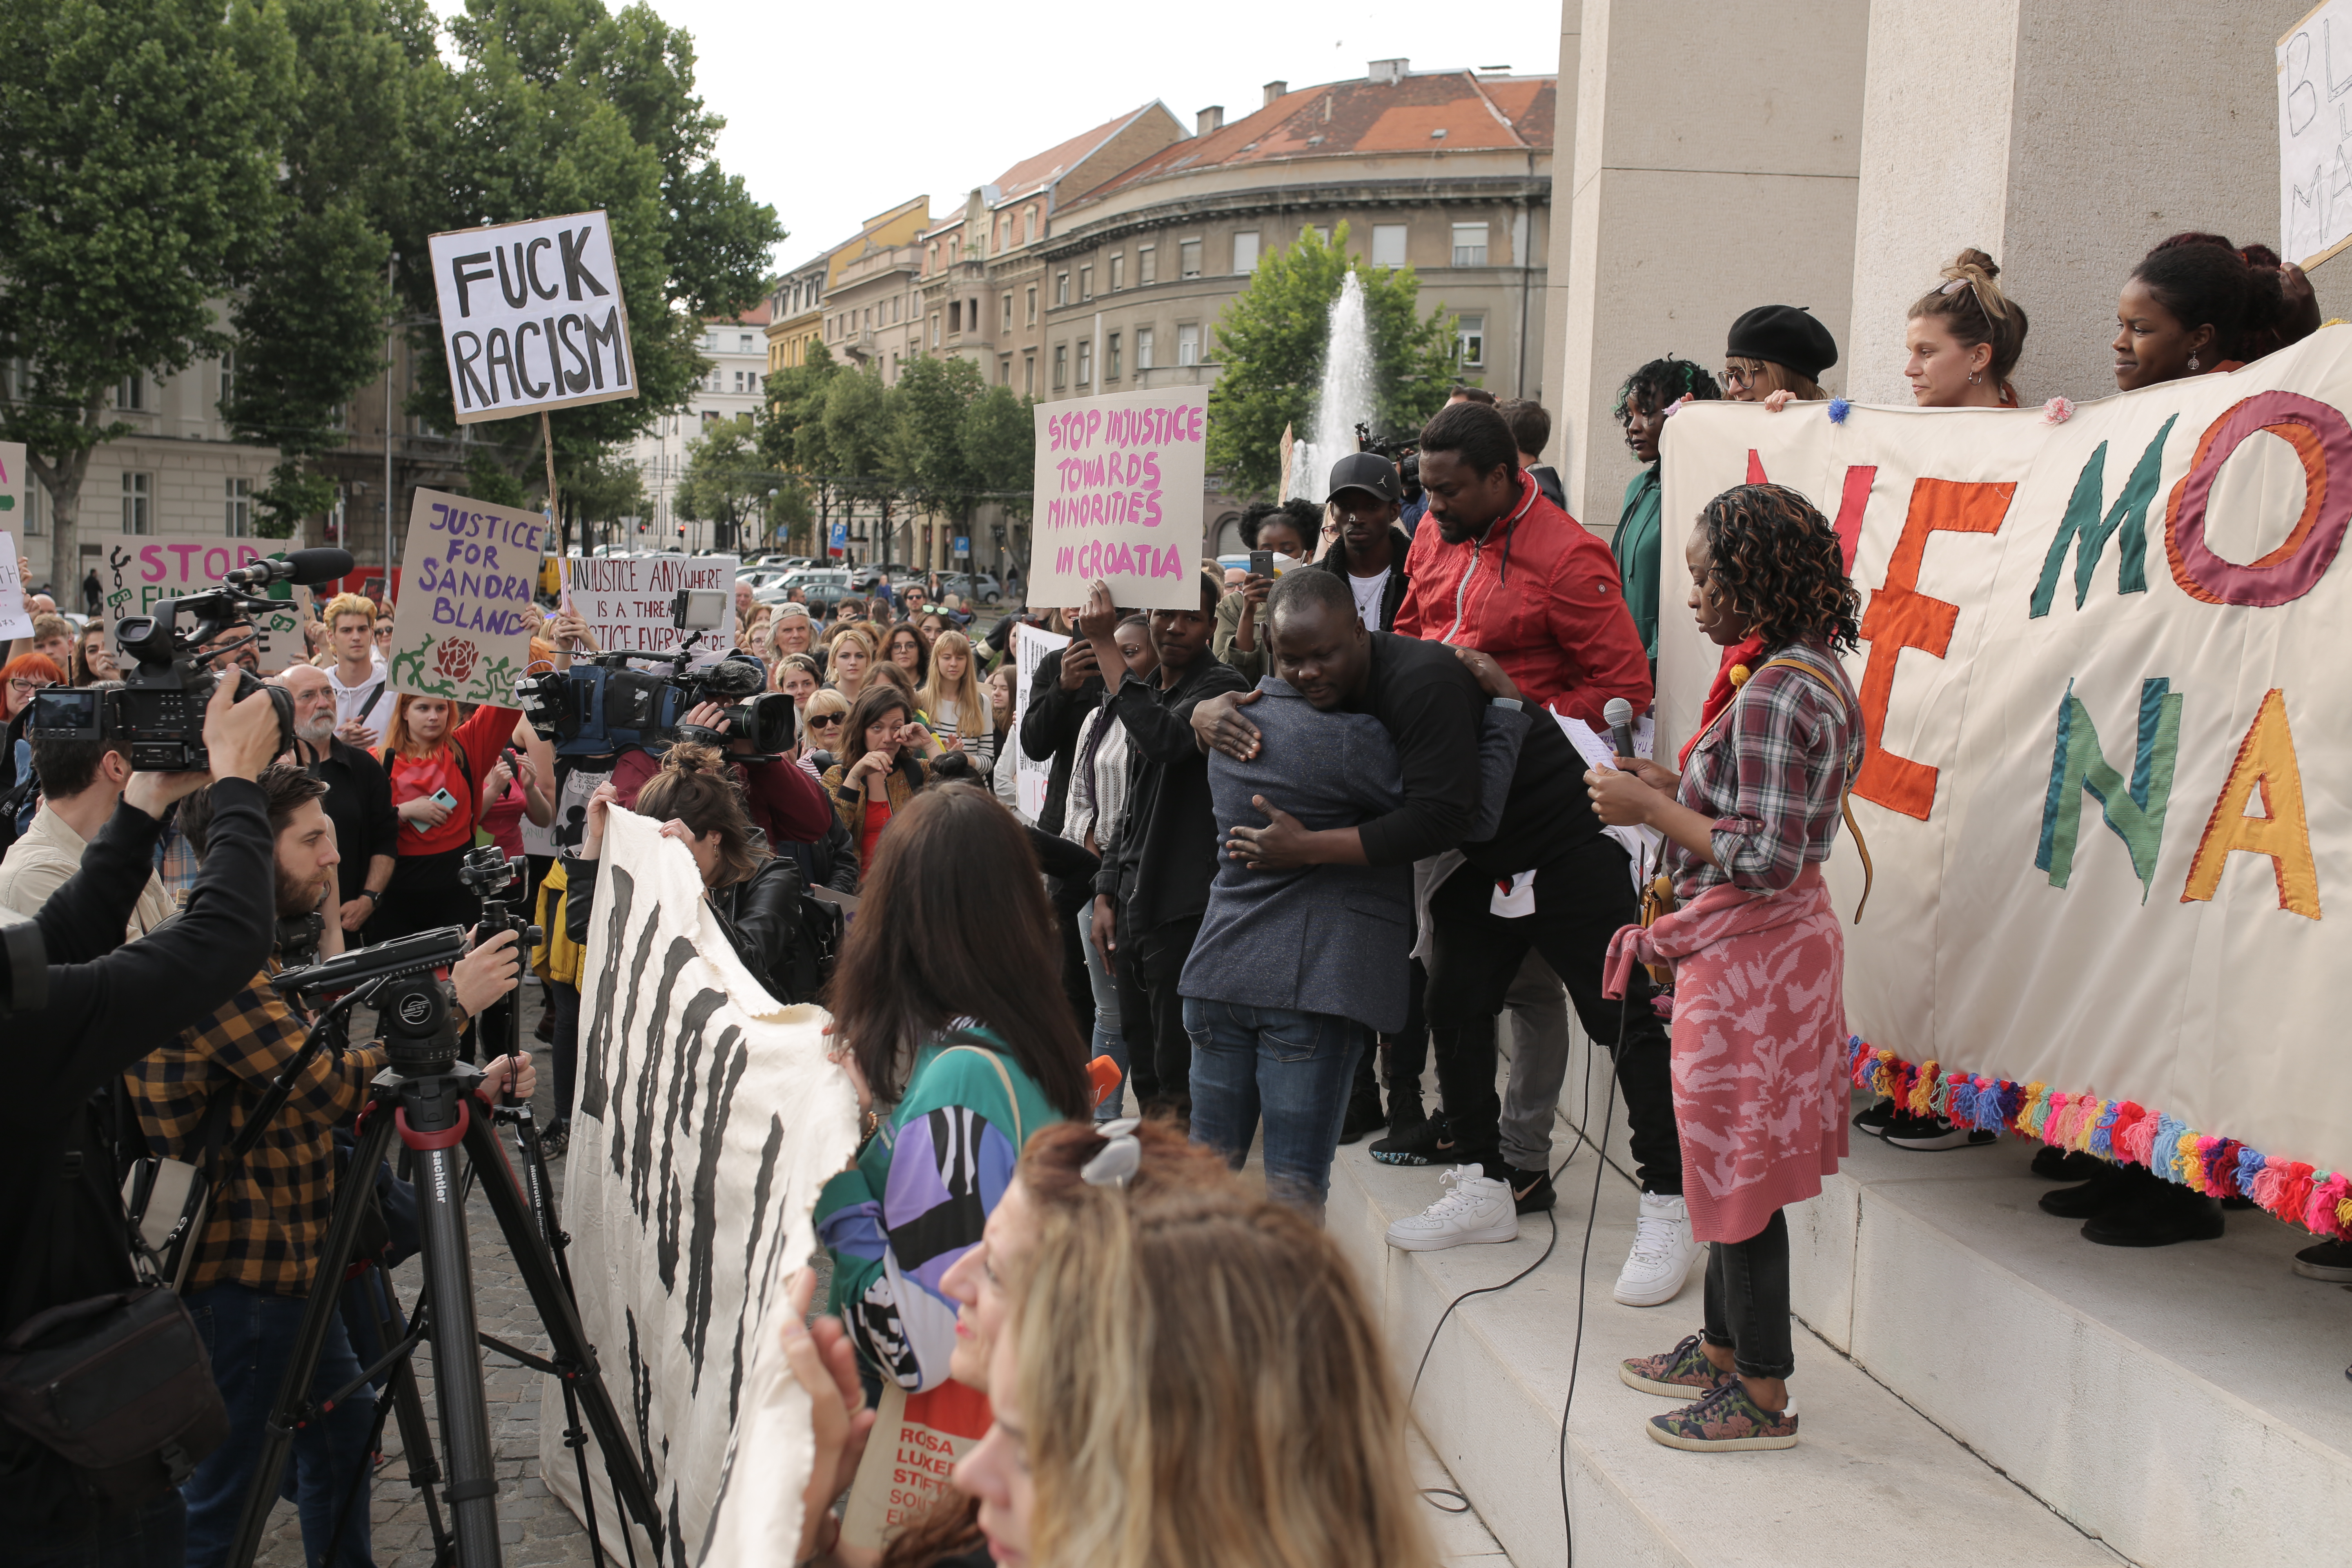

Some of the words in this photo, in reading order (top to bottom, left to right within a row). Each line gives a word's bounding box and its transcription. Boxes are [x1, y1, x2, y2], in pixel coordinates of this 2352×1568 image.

[452, 226, 610, 318] FUCK
[452, 305, 628, 408] RACISM
[1049, 409, 1101, 452] STOP
[1105, 404, 1203, 449] INJUSTICE
[1056, 451, 1161, 496] TOWARDS
[1047, 490, 1163, 533] MINORITIES
[2029, 390, 2352, 619] MO
[429, 503, 543, 552] JUSTICE
[834, 526, 844, 537] P
[958, 539, 965, 549] P
[139, 544, 260, 583] STOP
[446, 539, 500, 570] FOR
[573, 560, 638, 592] INJUSTICE
[649, 561, 722, 592] ANYWHERE
[1056, 546, 1074, 576] IN
[1078, 539, 1183, 581] CROATIA
[418, 557, 530, 604] SANDRA
[432, 597, 525, 636] BLAND
[598, 601, 608, 617] IS
[616, 601, 626, 618] A
[633, 601, 673, 617] THREA
[2035, 677, 2321, 920] NA
[432, 1151, 447, 1204] sachtler
[530, 1165, 542, 1208] Manfrotto
[900, 1428, 954, 1457] ROSA
[893, 1468, 947, 1495] STIFT
